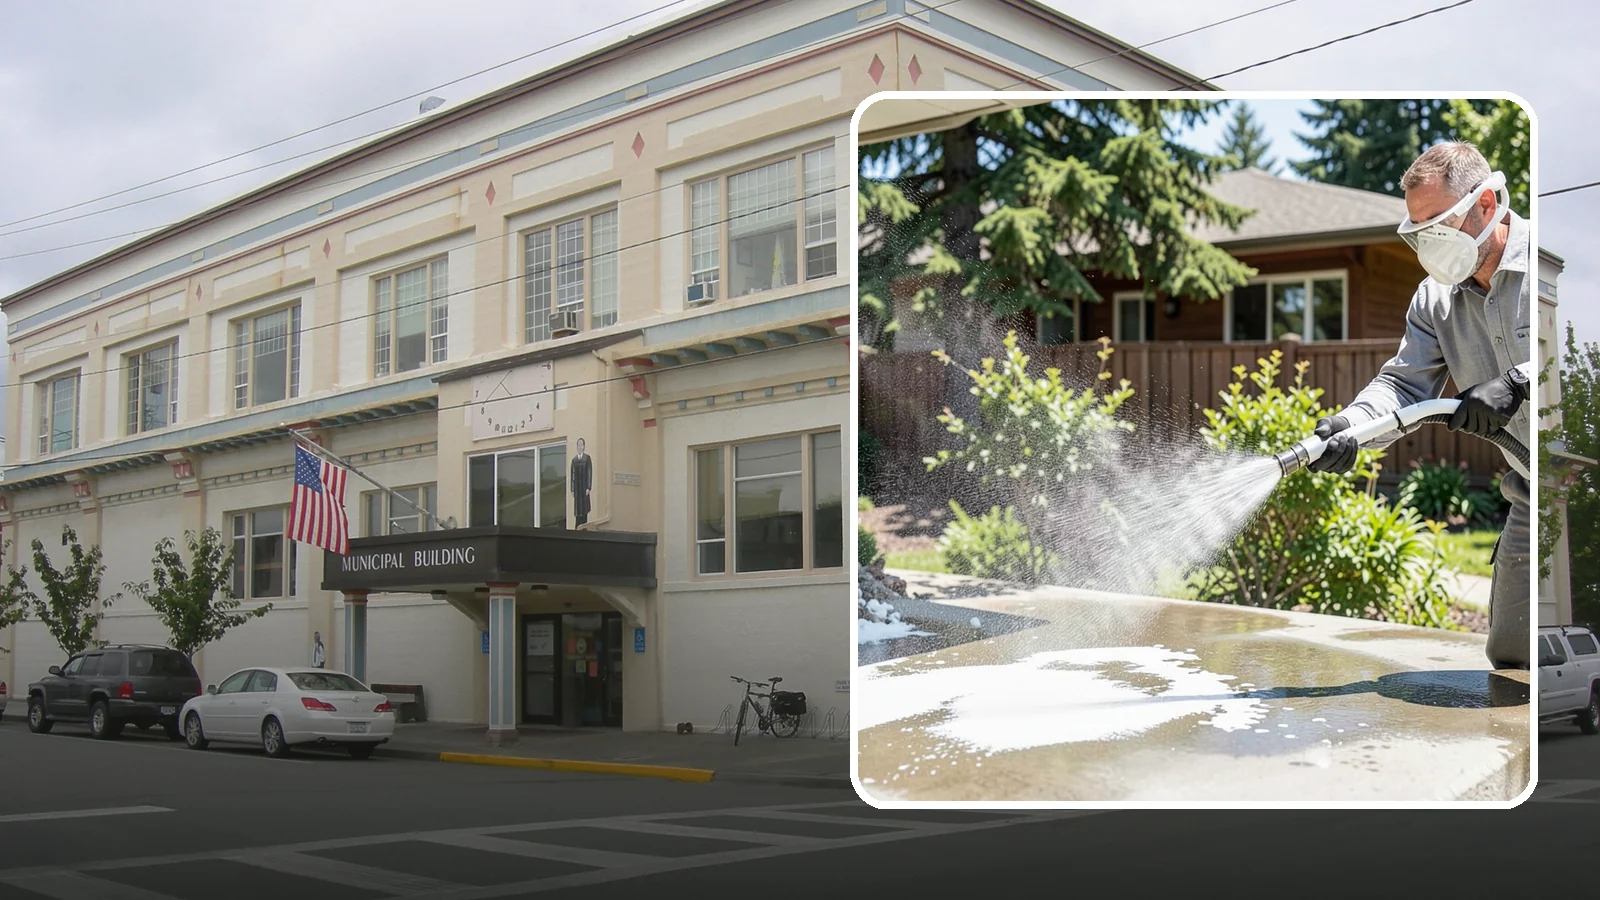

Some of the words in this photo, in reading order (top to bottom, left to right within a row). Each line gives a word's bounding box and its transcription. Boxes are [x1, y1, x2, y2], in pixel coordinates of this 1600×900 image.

[481, 407, 484, 415] 8
[342, 552, 405, 572] MUNICIPAL
[414, 546, 475, 566] BUILDING
